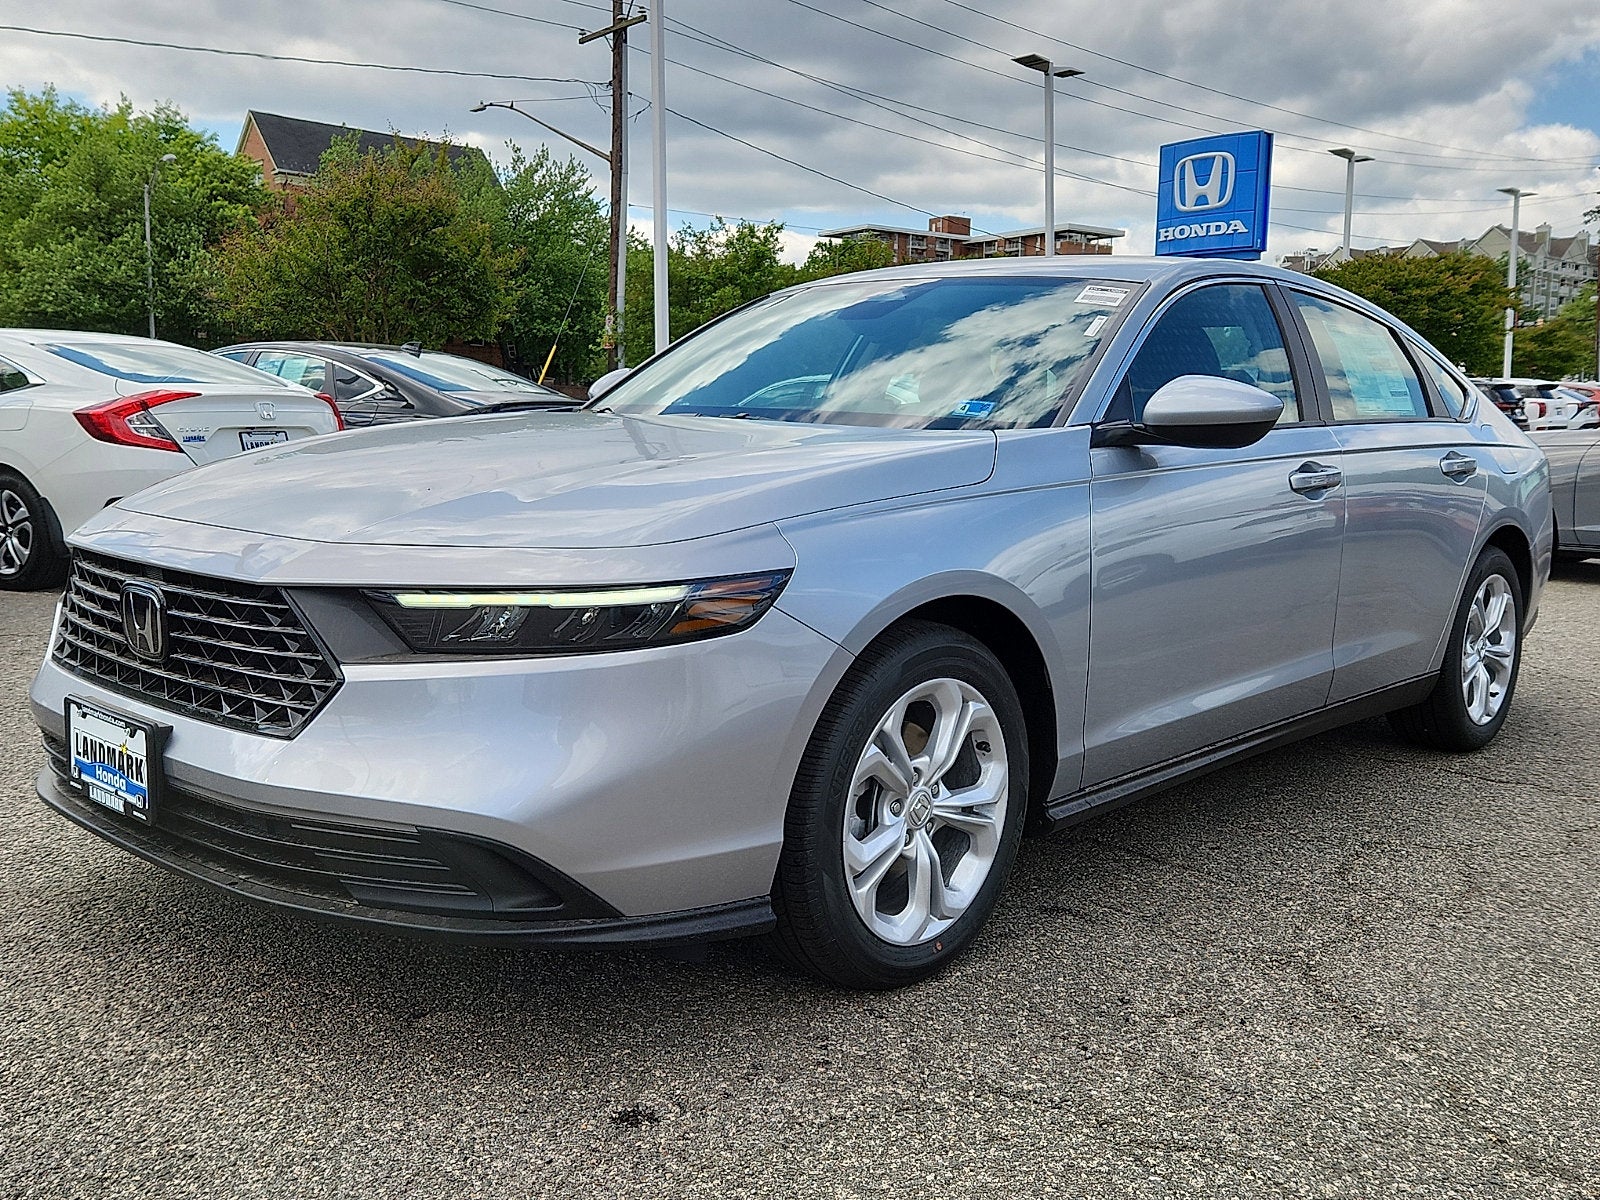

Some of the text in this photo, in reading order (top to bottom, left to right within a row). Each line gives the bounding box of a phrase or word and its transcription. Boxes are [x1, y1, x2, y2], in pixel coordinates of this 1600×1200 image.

[1158, 219, 1249, 242] HONDA
[75, 732, 146, 786] LANDMARK
[95, 764, 127, 792] Honda
[89, 784, 125, 813] LANDMARK
